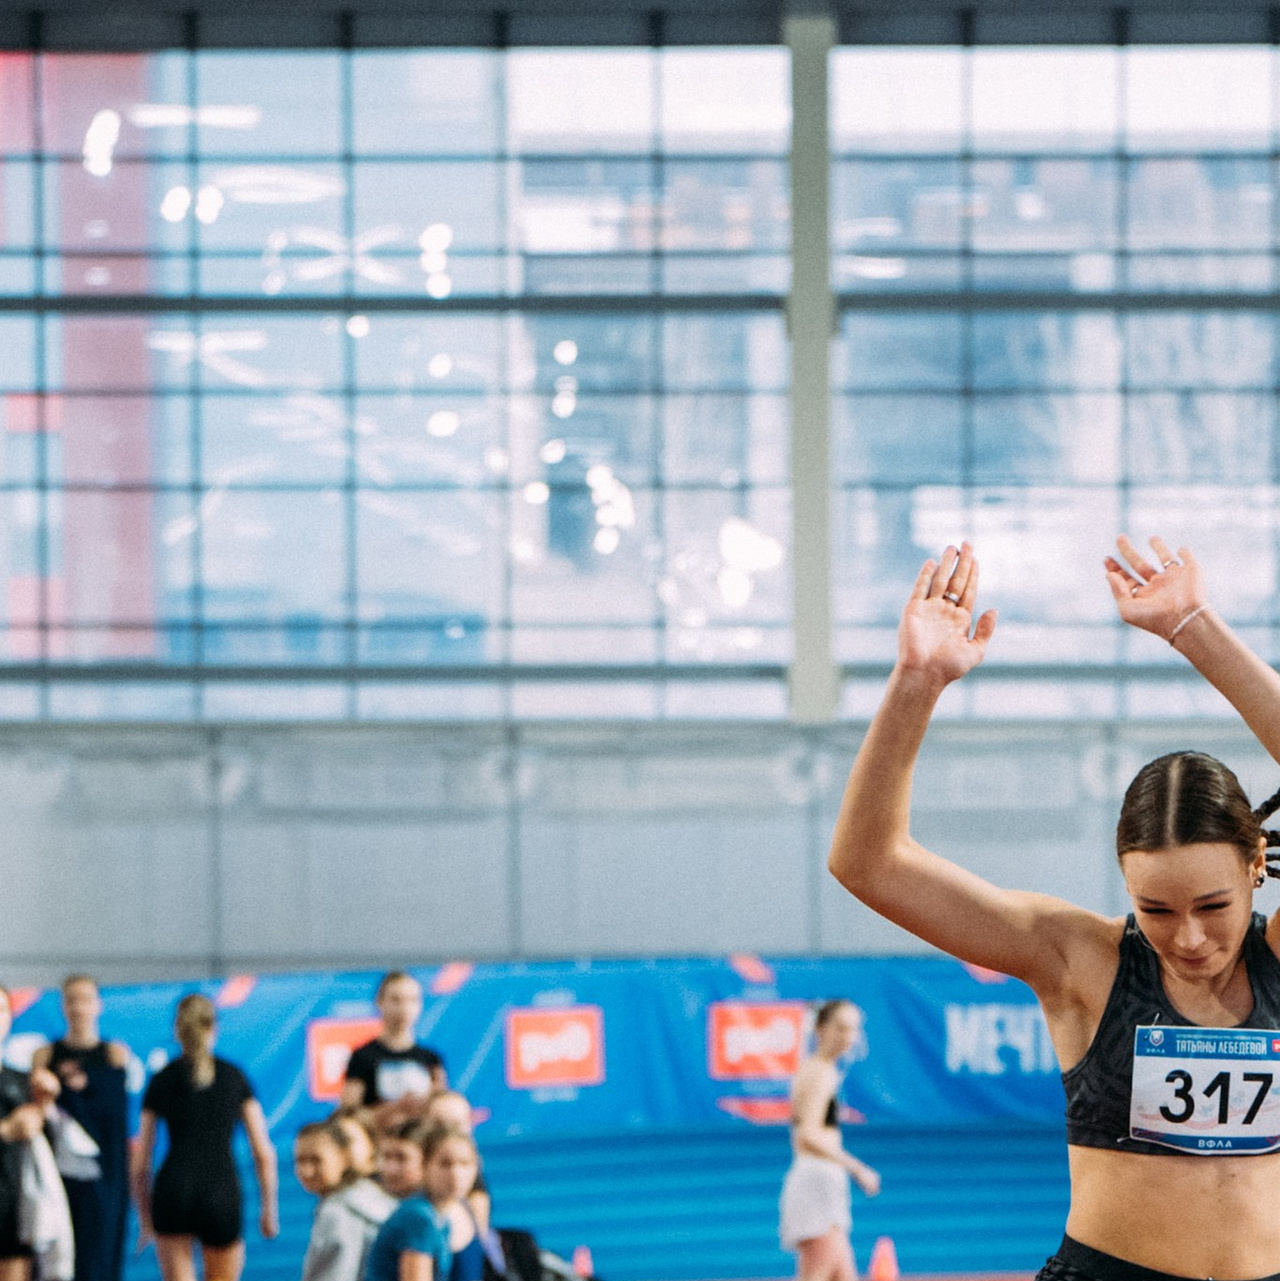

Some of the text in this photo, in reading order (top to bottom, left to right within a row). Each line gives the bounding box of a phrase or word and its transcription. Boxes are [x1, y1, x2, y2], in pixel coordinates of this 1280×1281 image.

[1176, 1039, 1267, 1056] ТАТЬЯНЫ ЛЕБЕДЕВОЙ
[1159, 1069, 1273, 1125] 317
[1198, 1139, 1232, 1149] ВФЛА
